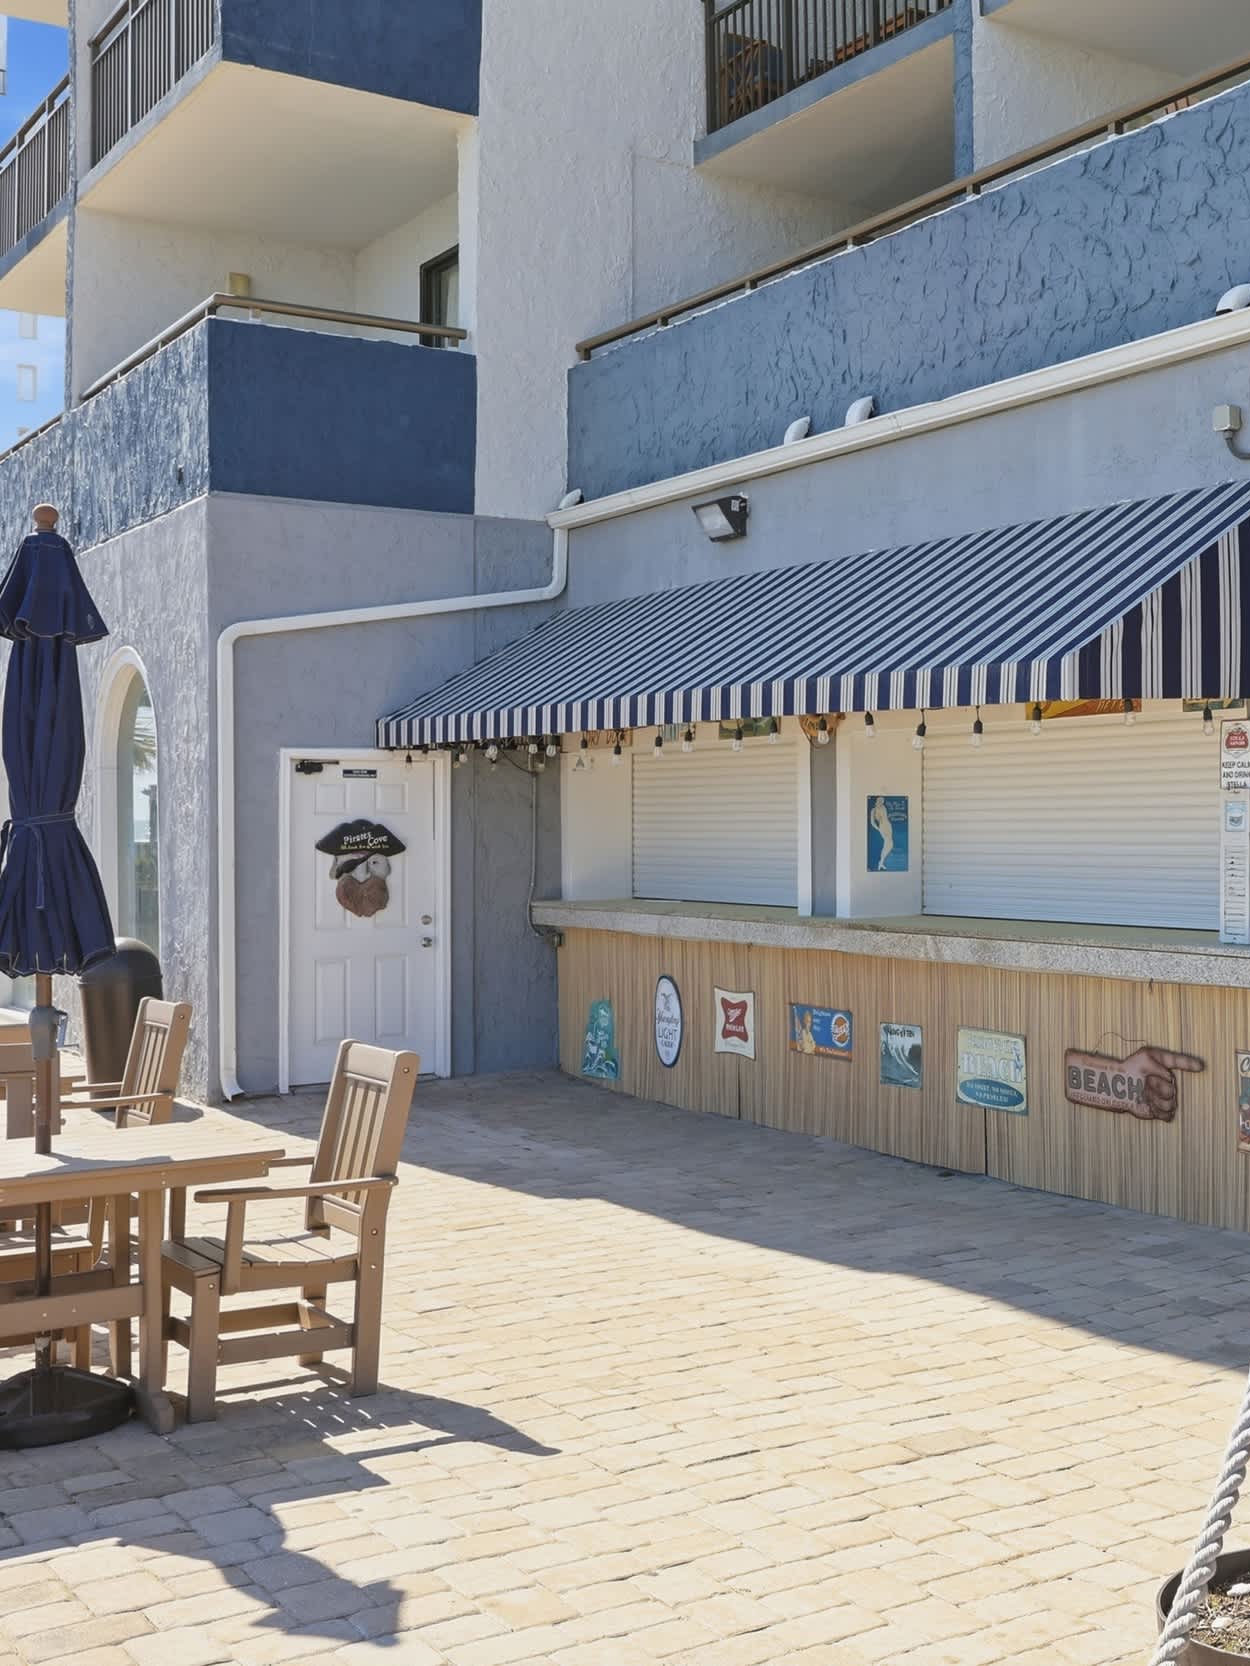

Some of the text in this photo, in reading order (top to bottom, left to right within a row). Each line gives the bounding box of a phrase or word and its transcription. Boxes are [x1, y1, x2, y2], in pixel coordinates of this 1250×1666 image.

[1222, 760, 1236, 769] KEEP
[1223, 770, 1234, 779] AND
[1227, 780, 1248, 789] STELLA
[658, 1026, 679, 1042] LIGHT
[1068, 1065, 1145, 1105] BEACH
